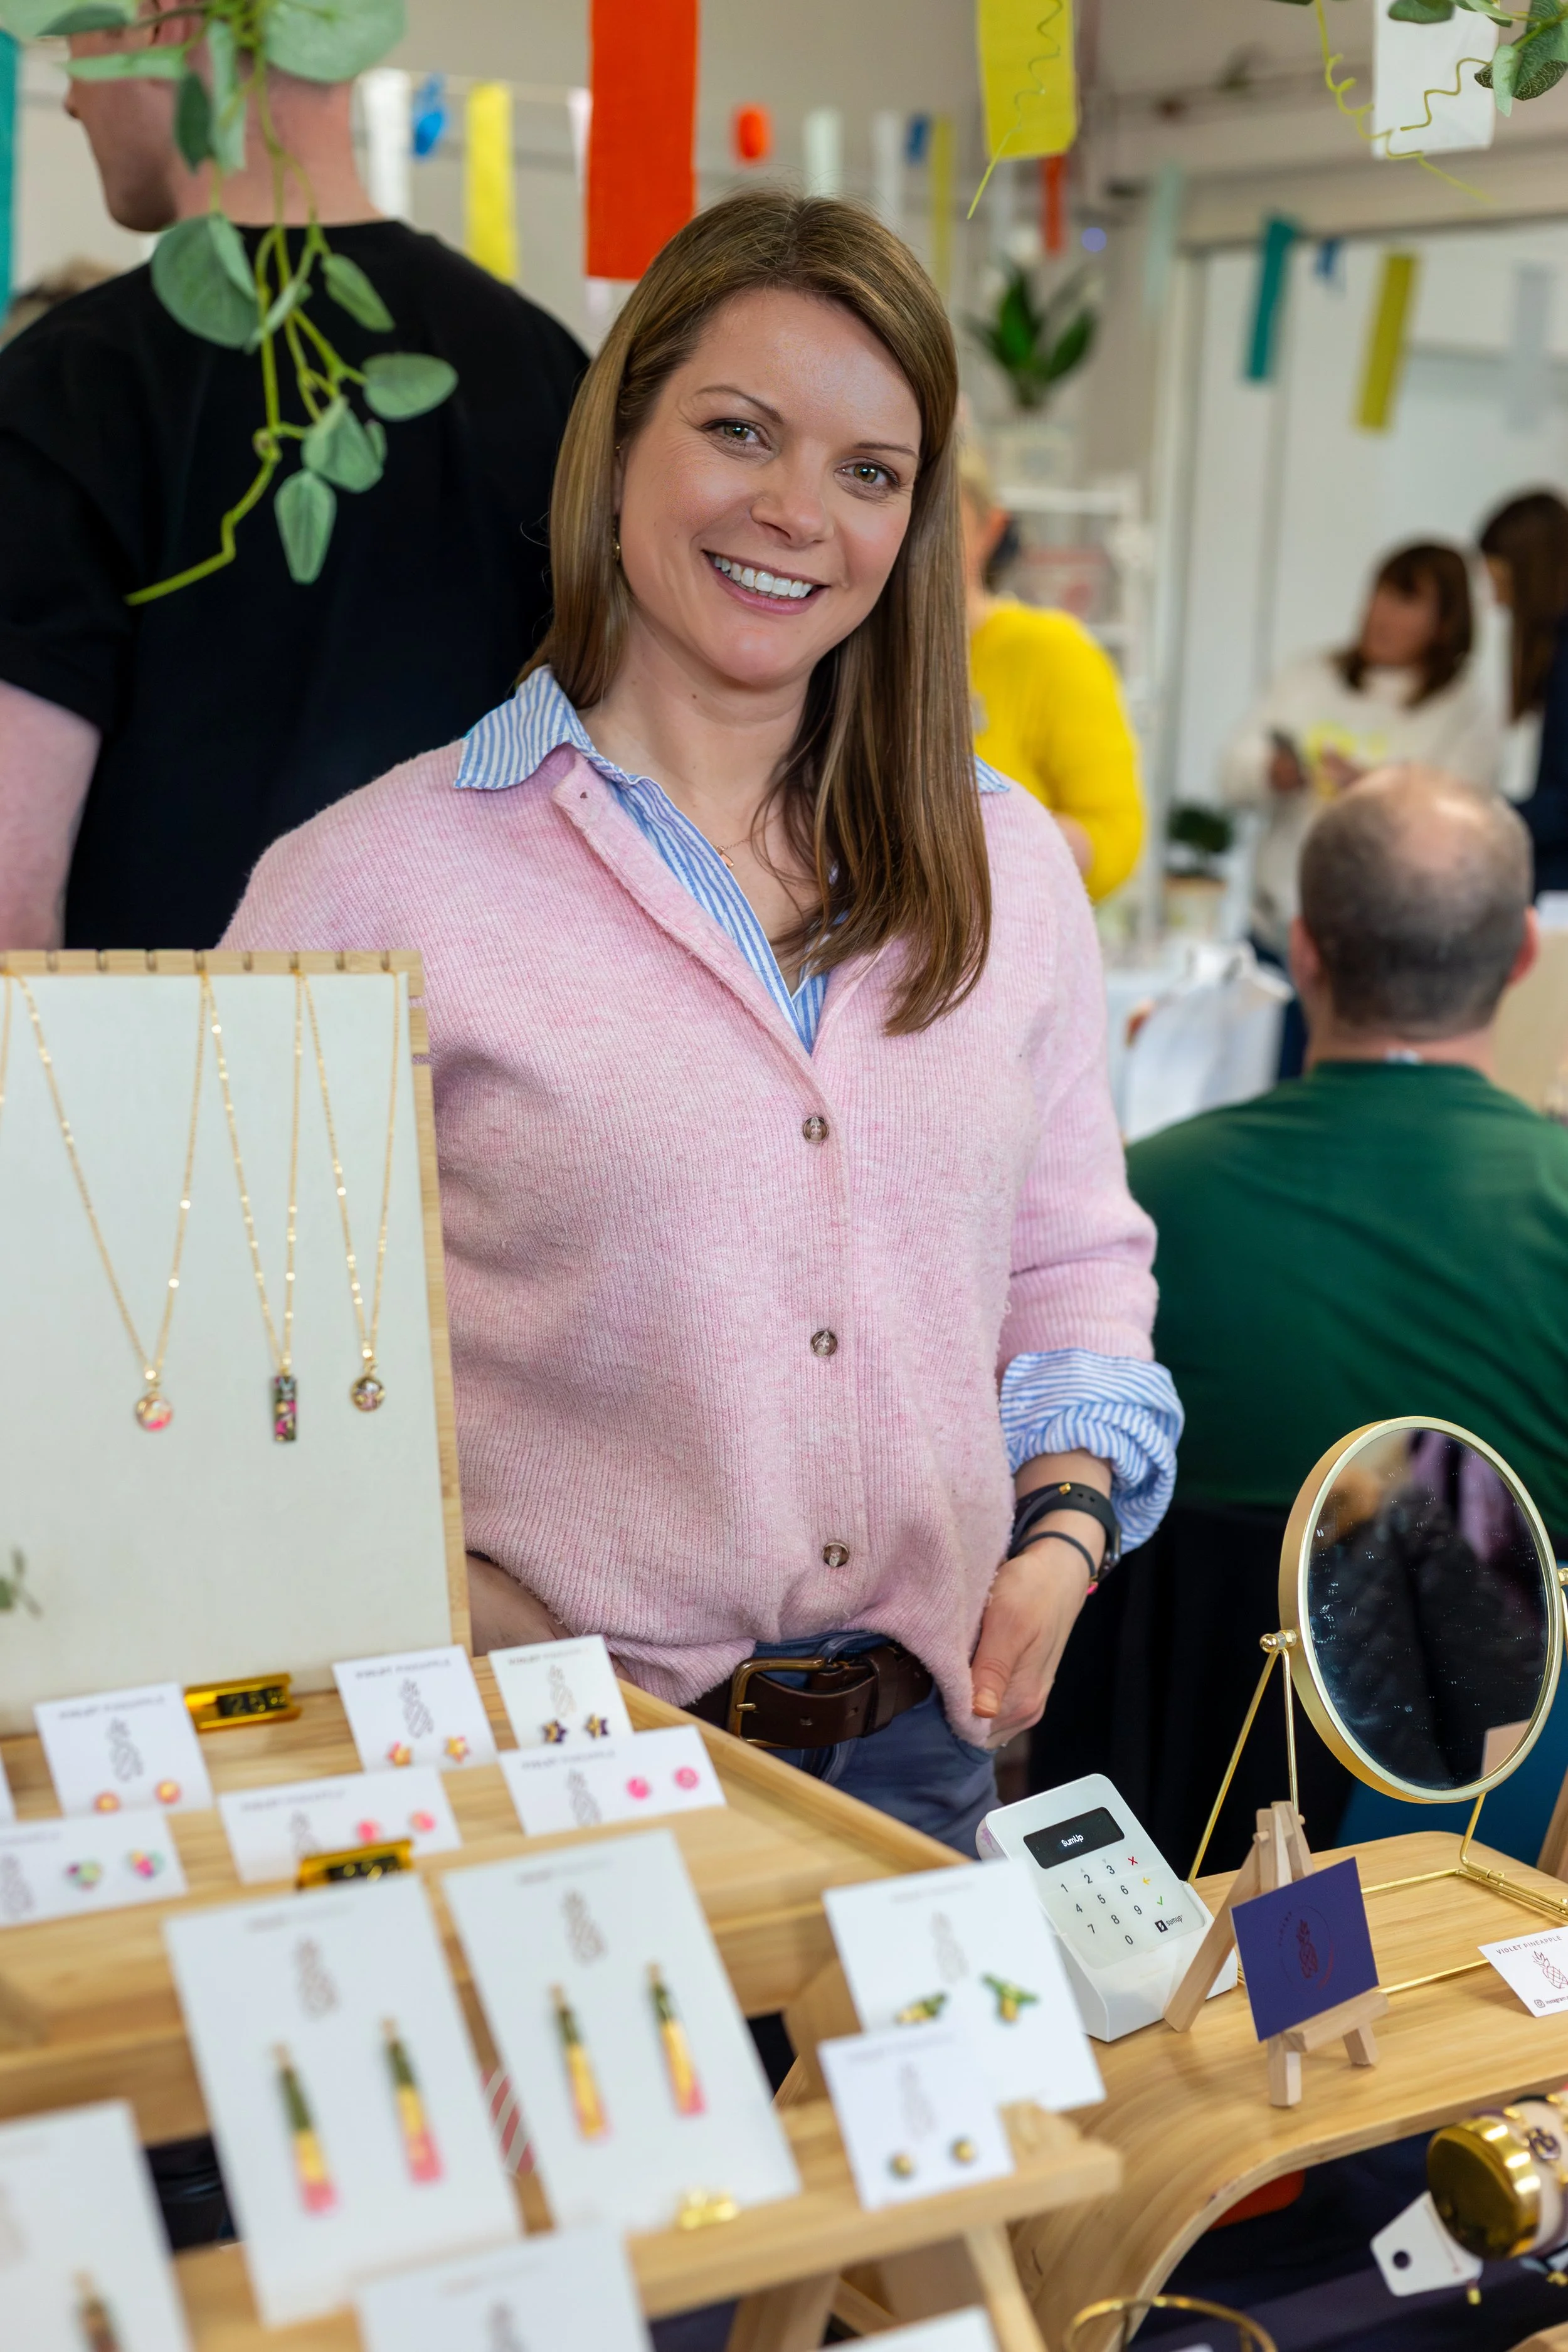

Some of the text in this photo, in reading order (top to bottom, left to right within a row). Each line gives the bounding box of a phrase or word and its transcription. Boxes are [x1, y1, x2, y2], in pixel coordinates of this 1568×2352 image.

[1061, 1834, 1084, 1847] SumUp
[1061, 1865, 1115, 1893] 1 2 3
[1076, 1885, 1129, 1913] 4 5 6
[1087, 1905, 1142, 1934] 7 8 9
[1125, 1935, 1133, 1945] 0
[1496, 1936, 1562, 1954] VIOLET PINEAPPLE
